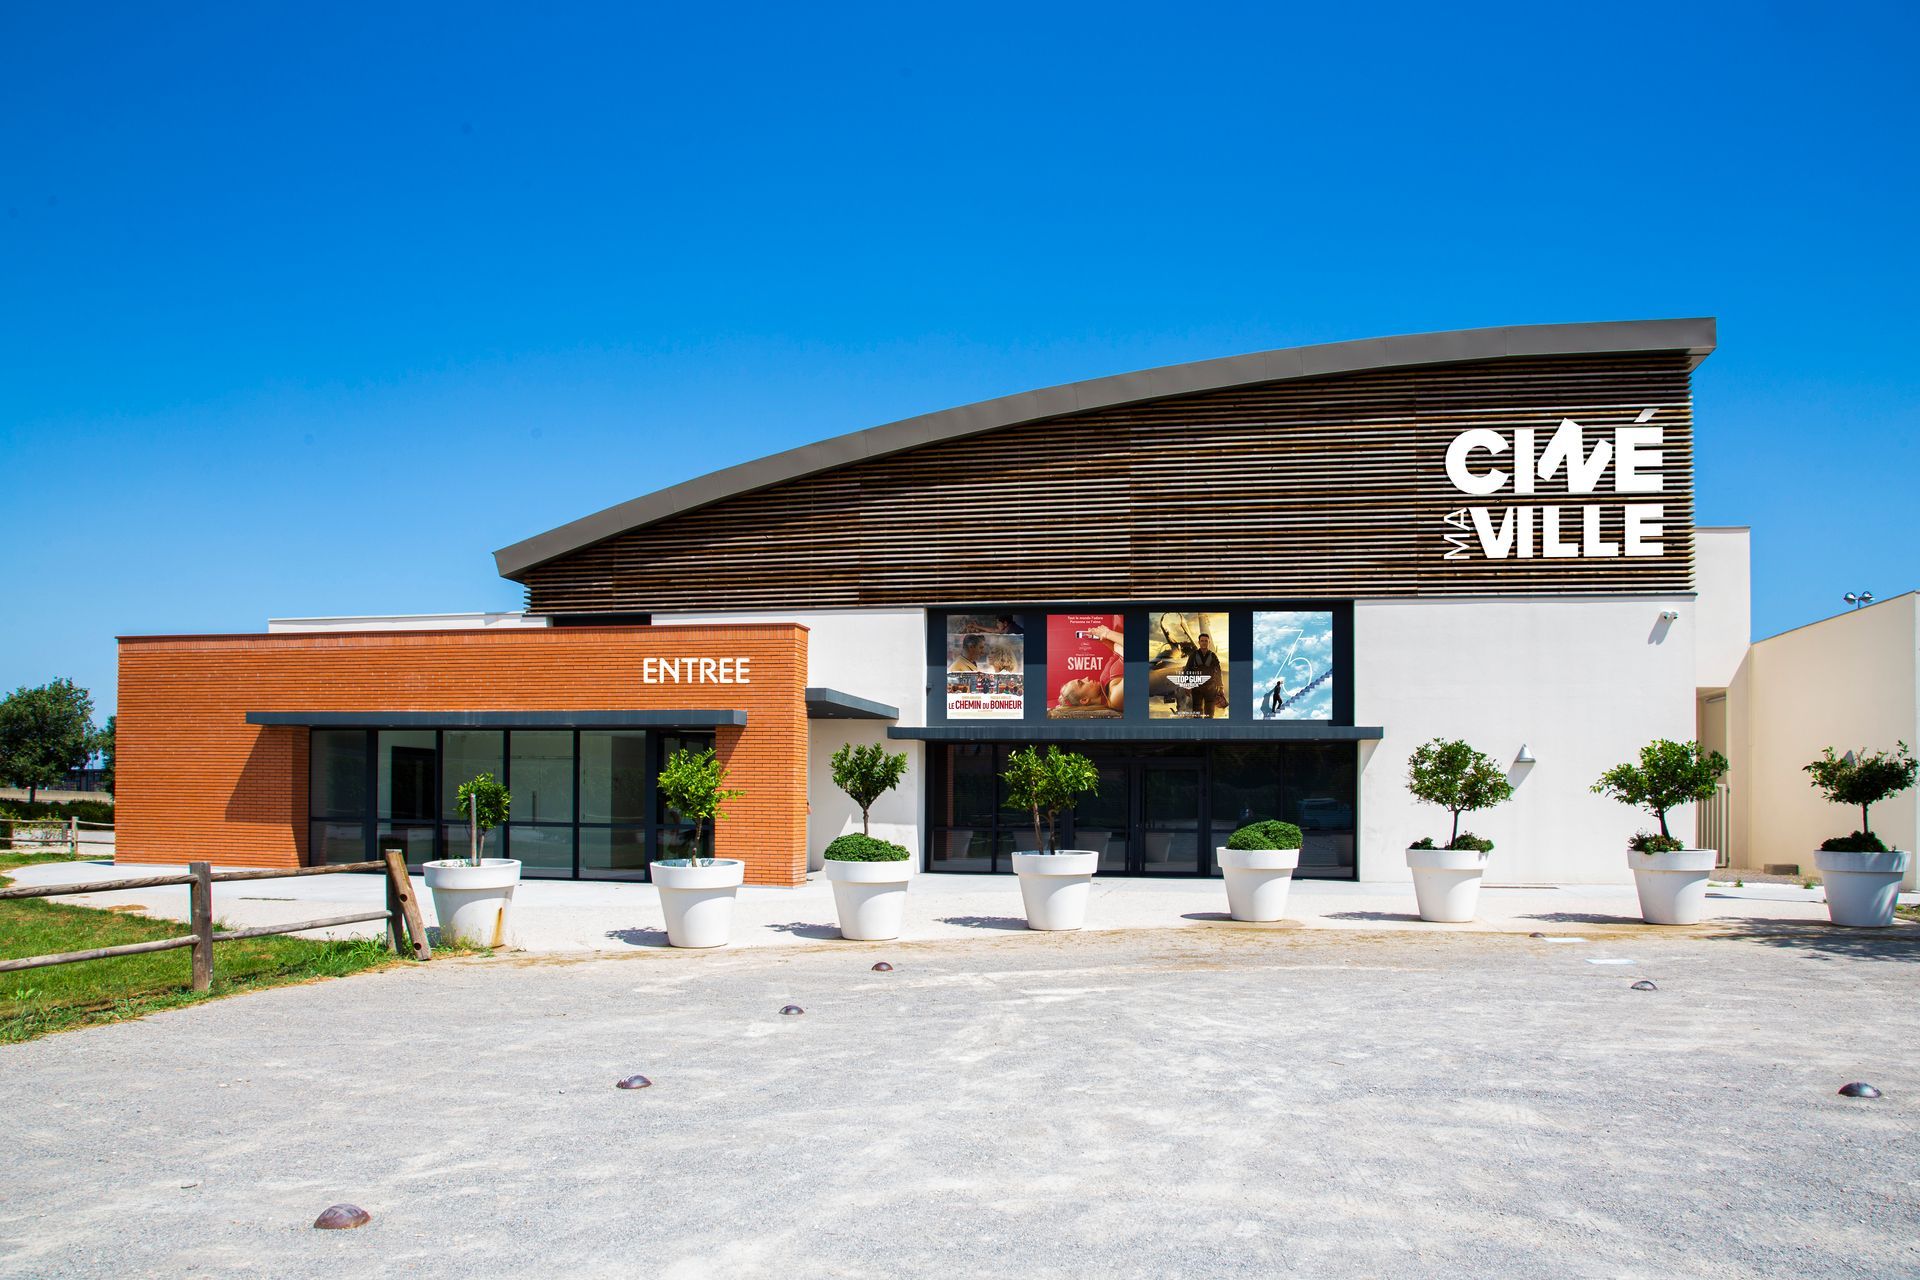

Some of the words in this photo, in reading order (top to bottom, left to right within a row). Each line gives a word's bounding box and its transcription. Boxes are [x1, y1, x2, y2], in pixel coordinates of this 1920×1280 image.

[1445, 408, 1664, 495] CINÉ
[1443, 508, 1470, 559] MA
[1468, 504, 1664, 559] VILLE
[643, 657, 751, 684] ENTREE
[1067, 656, 1104, 671] SWEAT
[1177, 675, 1189, 683] TOP
[1189, 675, 1202, 683] GUN
[948, 702, 955, 710] LE
[955, 700, 982, 710] CHEMIN
[982, 702, 990, 710] DU
[990, 700, 1022, 710] BONHEUR
